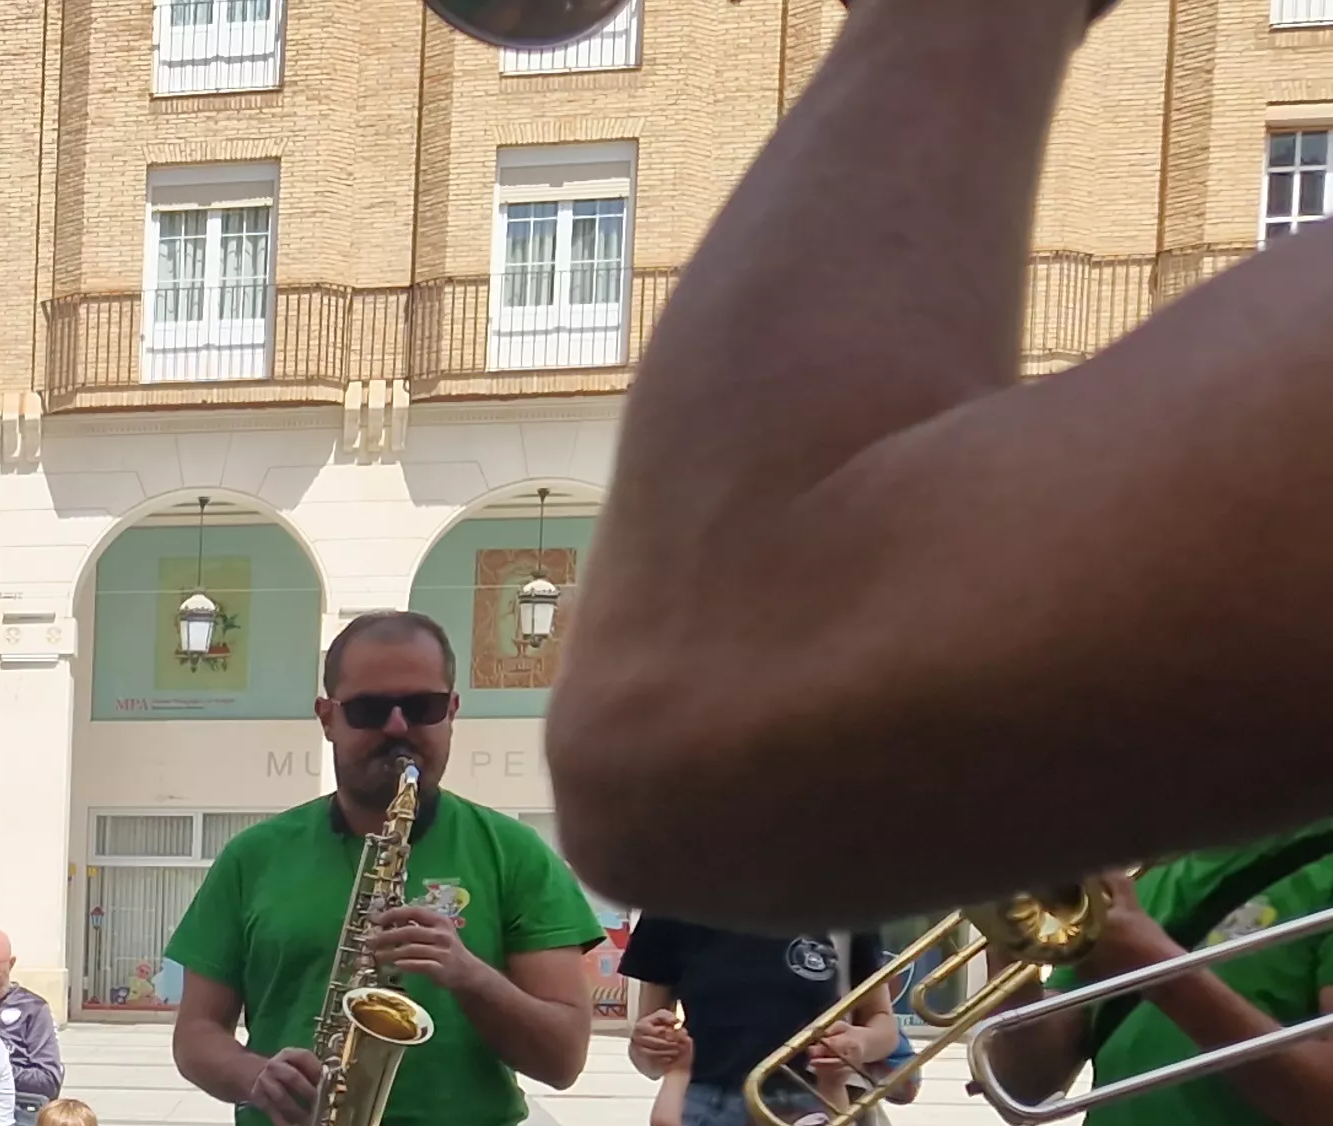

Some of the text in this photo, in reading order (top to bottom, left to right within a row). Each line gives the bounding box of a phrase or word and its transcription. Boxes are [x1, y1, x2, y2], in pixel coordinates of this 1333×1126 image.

[115, 698, 148, 711] MPA
[267, 751, 538, 777] MU PE
